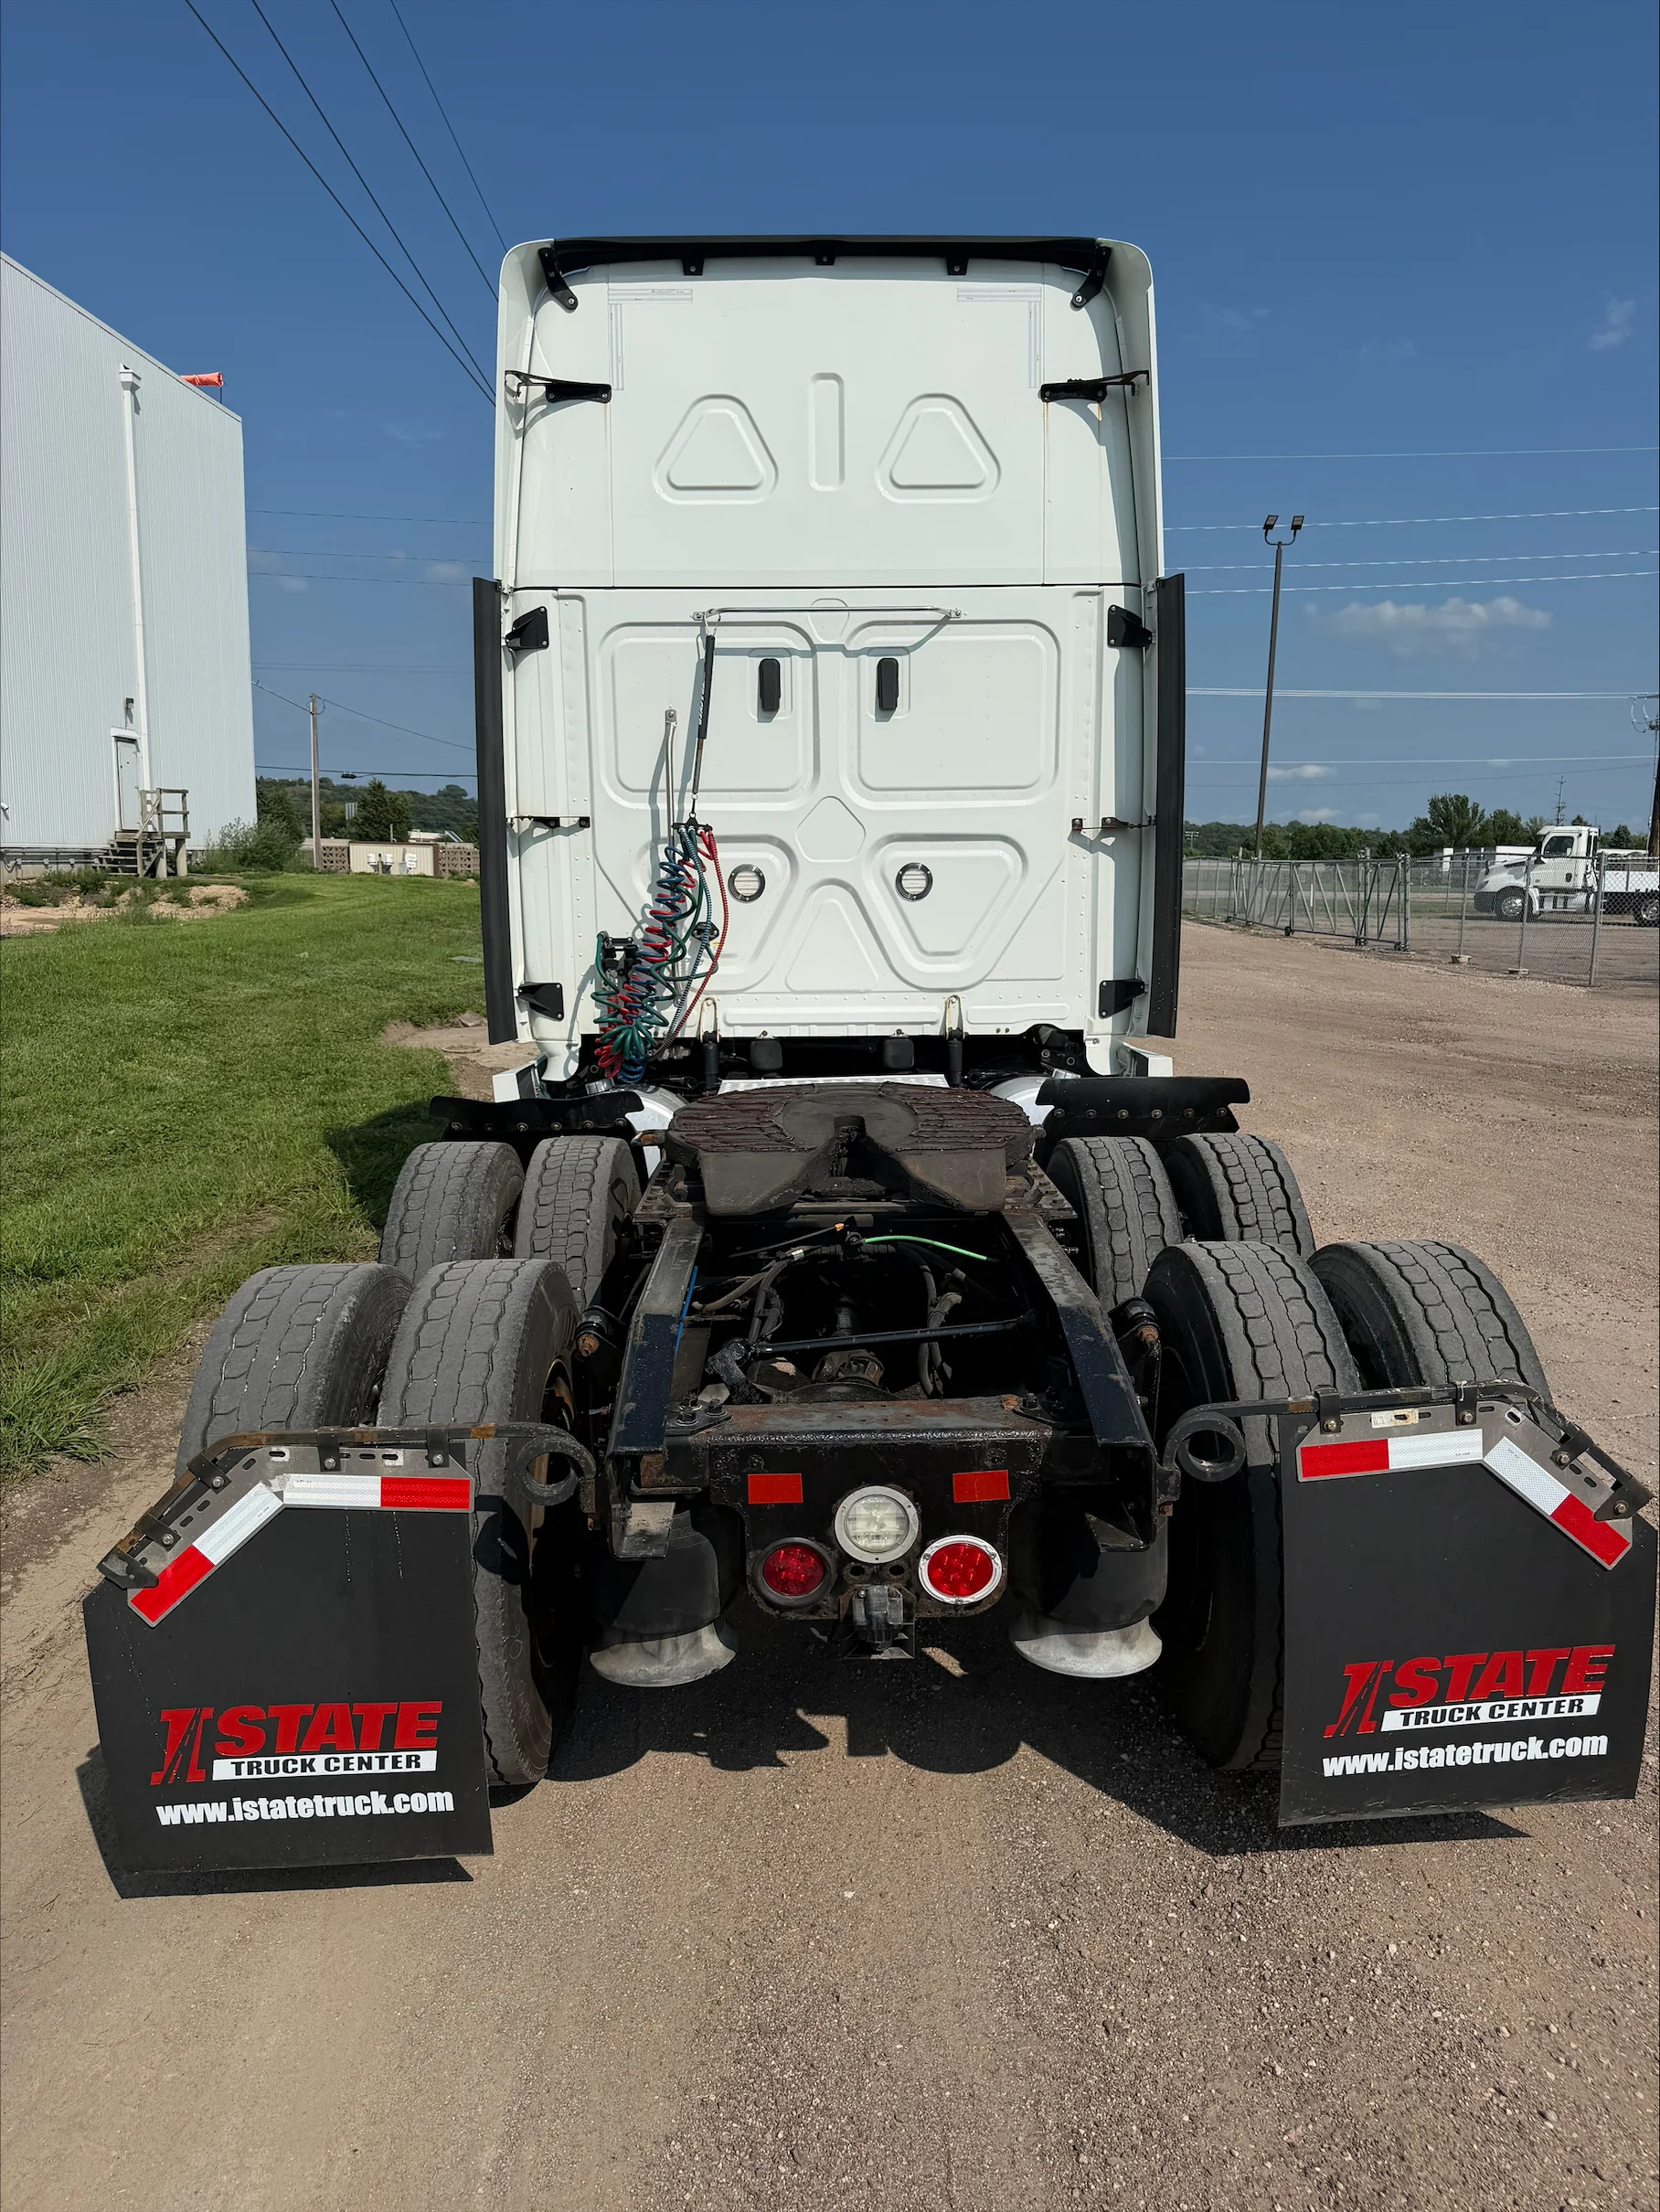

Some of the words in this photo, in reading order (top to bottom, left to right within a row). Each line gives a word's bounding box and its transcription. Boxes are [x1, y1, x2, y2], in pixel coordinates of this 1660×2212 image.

[1399, 1705, 1483, 1727] TRUCK
[1488, 1698, 1584, 1719] CENTER
[230, 1757, 317, 1776] TRUCK
[324, 1753, 421, 1772] CENTER
[1322, 1733, 1609, 1777] www.istatetruck.com
[155, 1790, 454, 1825] www.istatetruck.com
